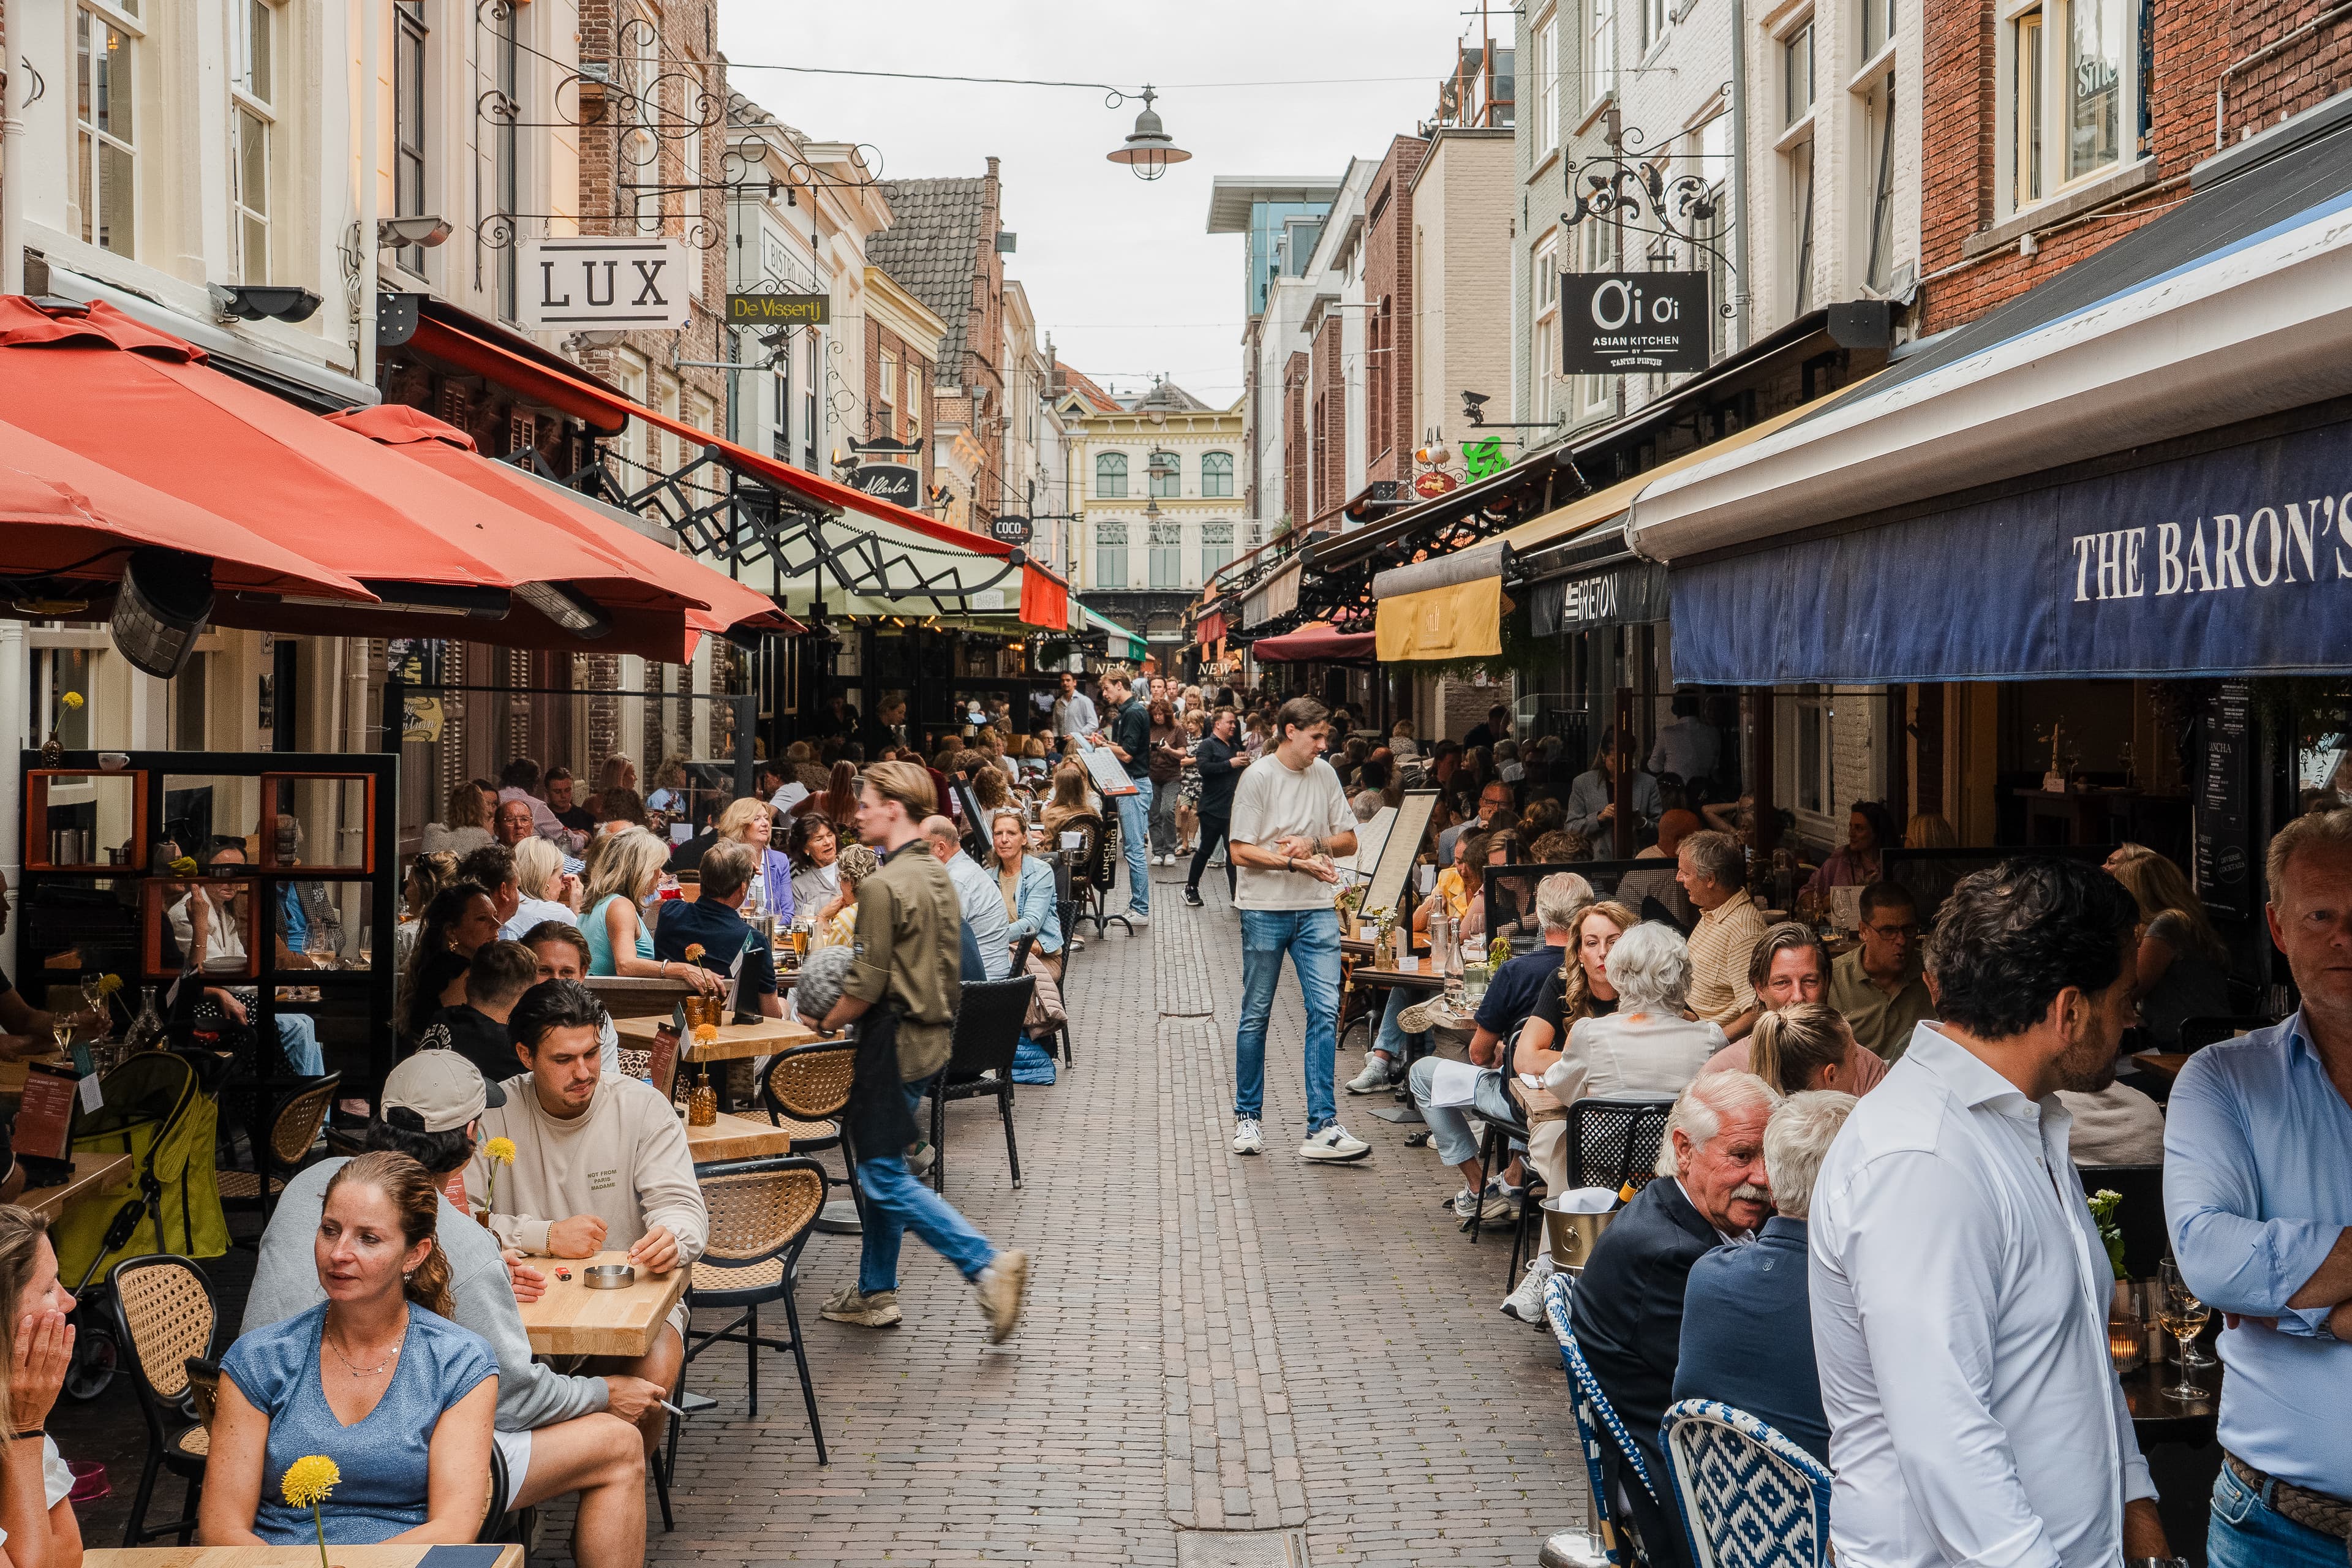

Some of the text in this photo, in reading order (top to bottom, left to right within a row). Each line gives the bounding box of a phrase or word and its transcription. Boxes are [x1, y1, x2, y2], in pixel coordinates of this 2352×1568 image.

[771, 243, 796, 283] BISTRO
[540, 259, 668, 307] LUX
[734, 297, 821, 323] De Visserij
[1593, 336, 1679, 346] ASIAN KITCHEN
[1611, 357, 1662, 367] TANTE PIETJE
[859, 475, 910, 495] Allerlei
[996, 522, 1022, 534] COCO
[2072, 527, 2146, 602] THE
[1197, 663, 1232, 675] NEW
[2220, 853, 2241, 864] DIVERSE
[2218, 861, 2245, 874] COCKTAILS
[591, 1182, 616, 1191] MADAME
